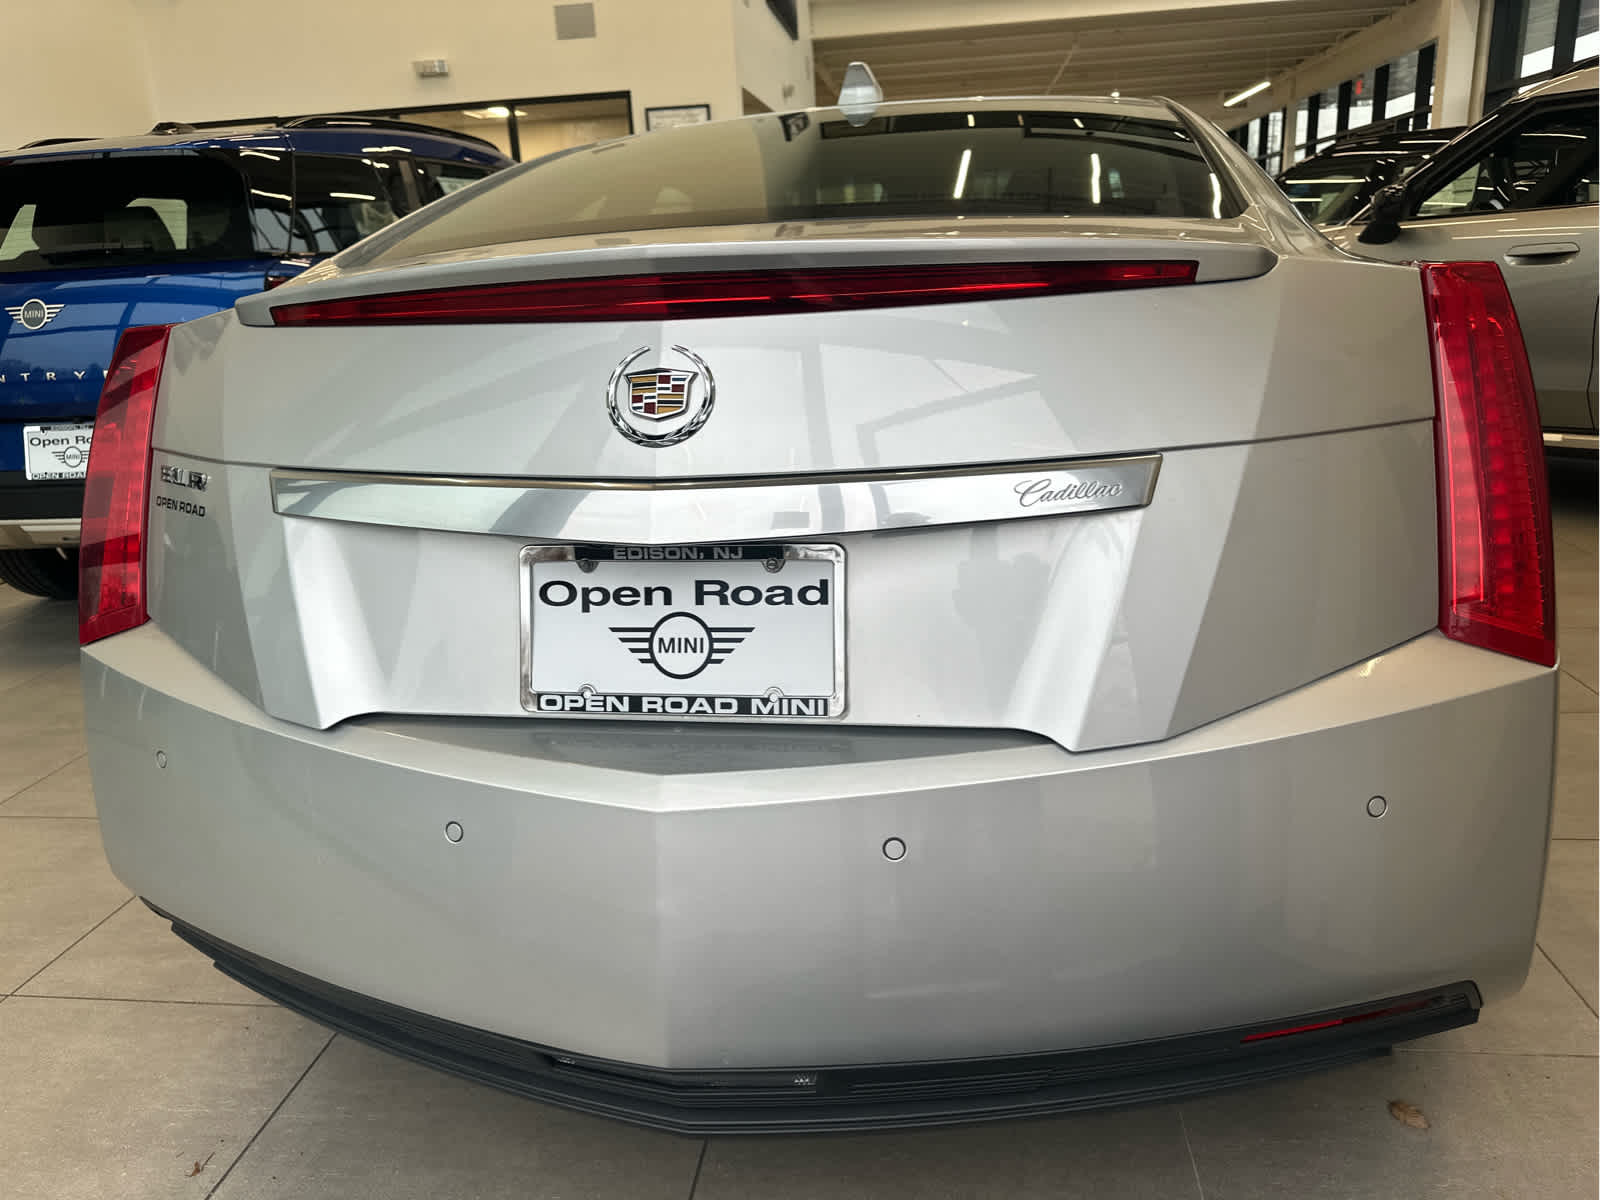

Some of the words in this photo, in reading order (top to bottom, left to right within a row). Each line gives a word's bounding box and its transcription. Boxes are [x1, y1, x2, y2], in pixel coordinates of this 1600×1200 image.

[24, 309, 44, 319] MINI
[30, 437, 70, 449] Open
[1013, 478, 1122, 507] Cadillac
[156, 495, 178, 511] OPEN
[179, 501, 206, 517] ROAD
[613, 546, 705, 560] EDISON,
[712, 546, 744, 560] NJ
[539, 580, 673, 613] Open
[694, 579, 829, 606] Road
[657, 637, 704, 654] MINI
[539, 694, 630, 712] OPEN
[642, 696, 739, 714] ROAD
[751, 697, 826, 716] MINI
